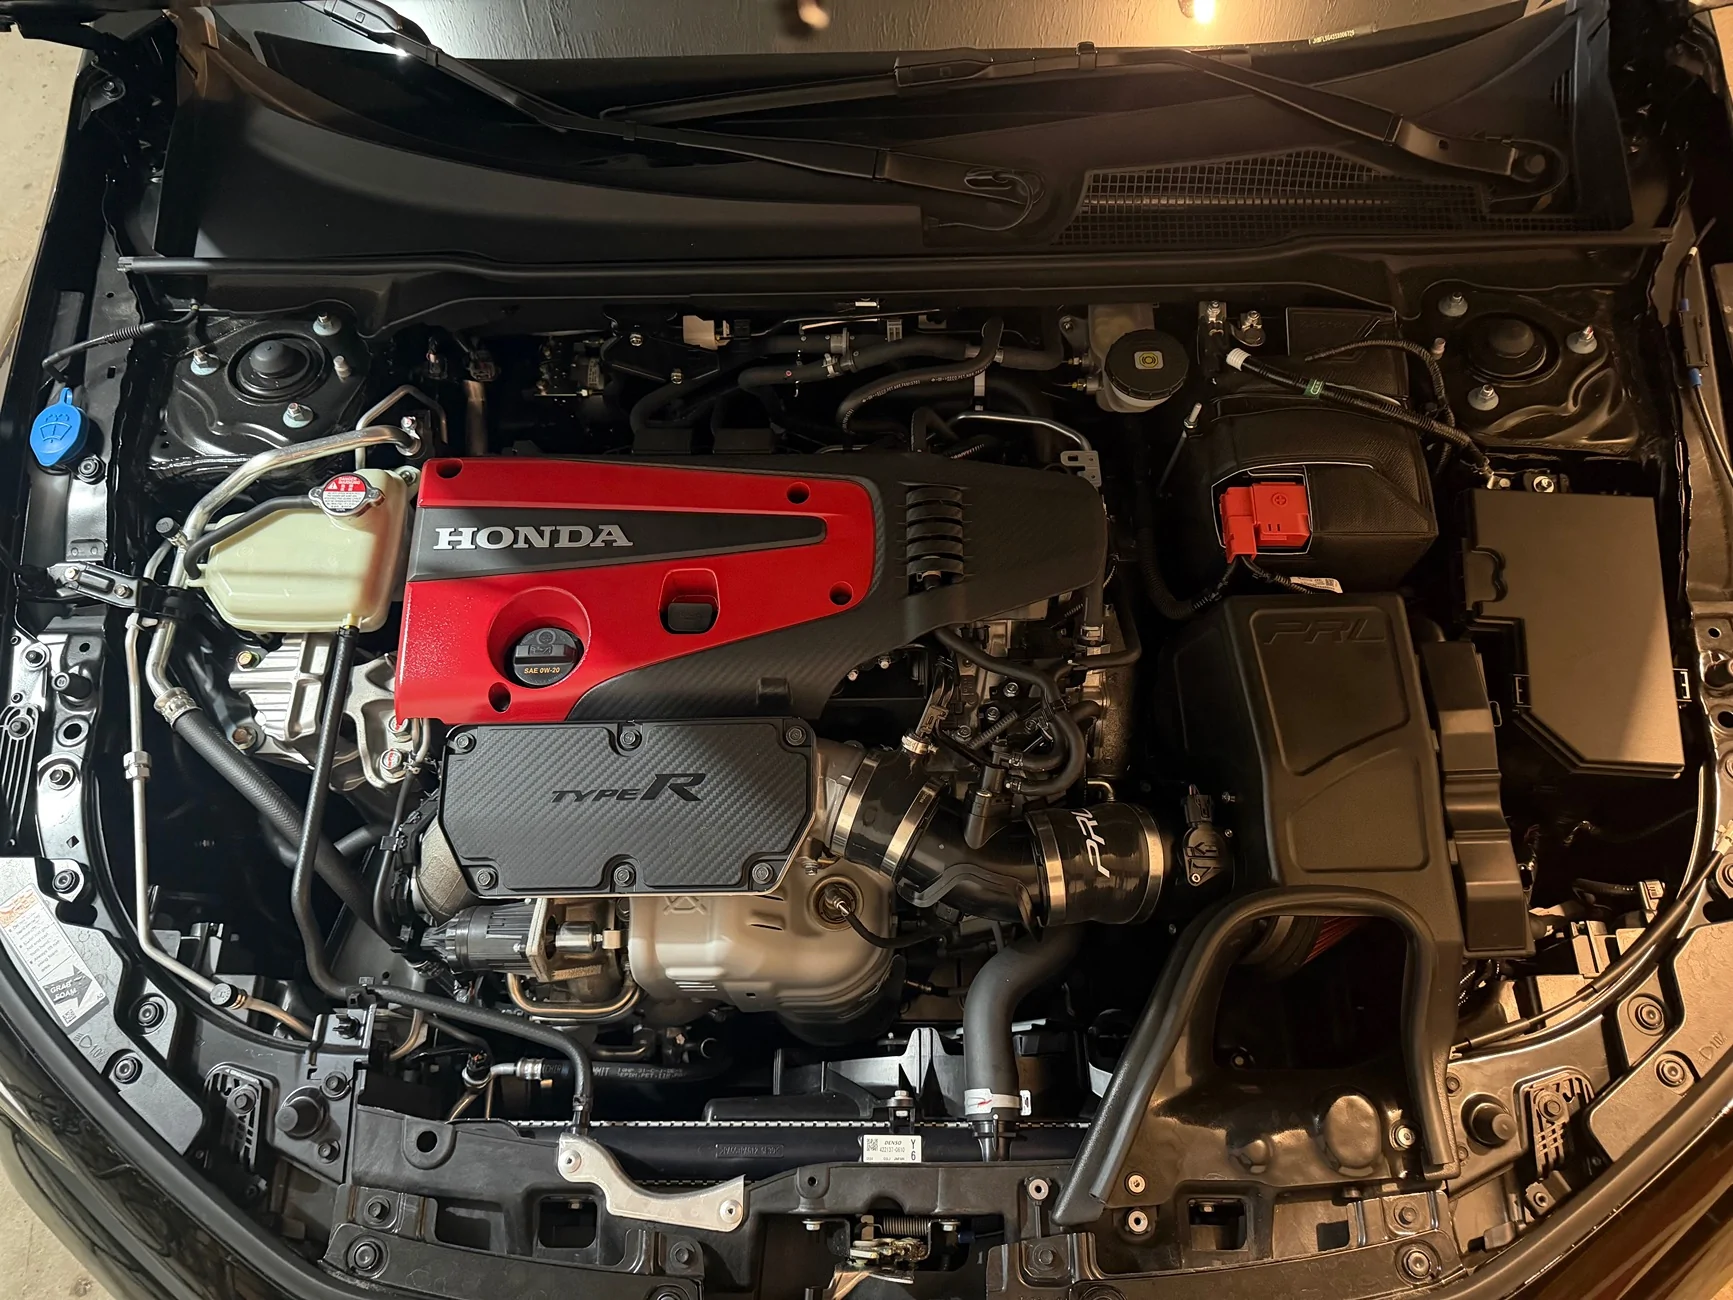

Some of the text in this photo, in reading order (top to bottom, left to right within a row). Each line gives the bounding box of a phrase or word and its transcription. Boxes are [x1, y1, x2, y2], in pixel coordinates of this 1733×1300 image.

[433, 524, 634, 550] HONDA
[1263, 618, 1386, 645] PRL
[539, 666, 561, 674] 0W-20
[551, 772, 707, 803] TYPE R
[1070, 807, 1111, 879] PRL
[50, 980, 73, 994] GRAB
[910, 1138, 917, 1150] Y
[910, 1150, 917, 1161] 6
